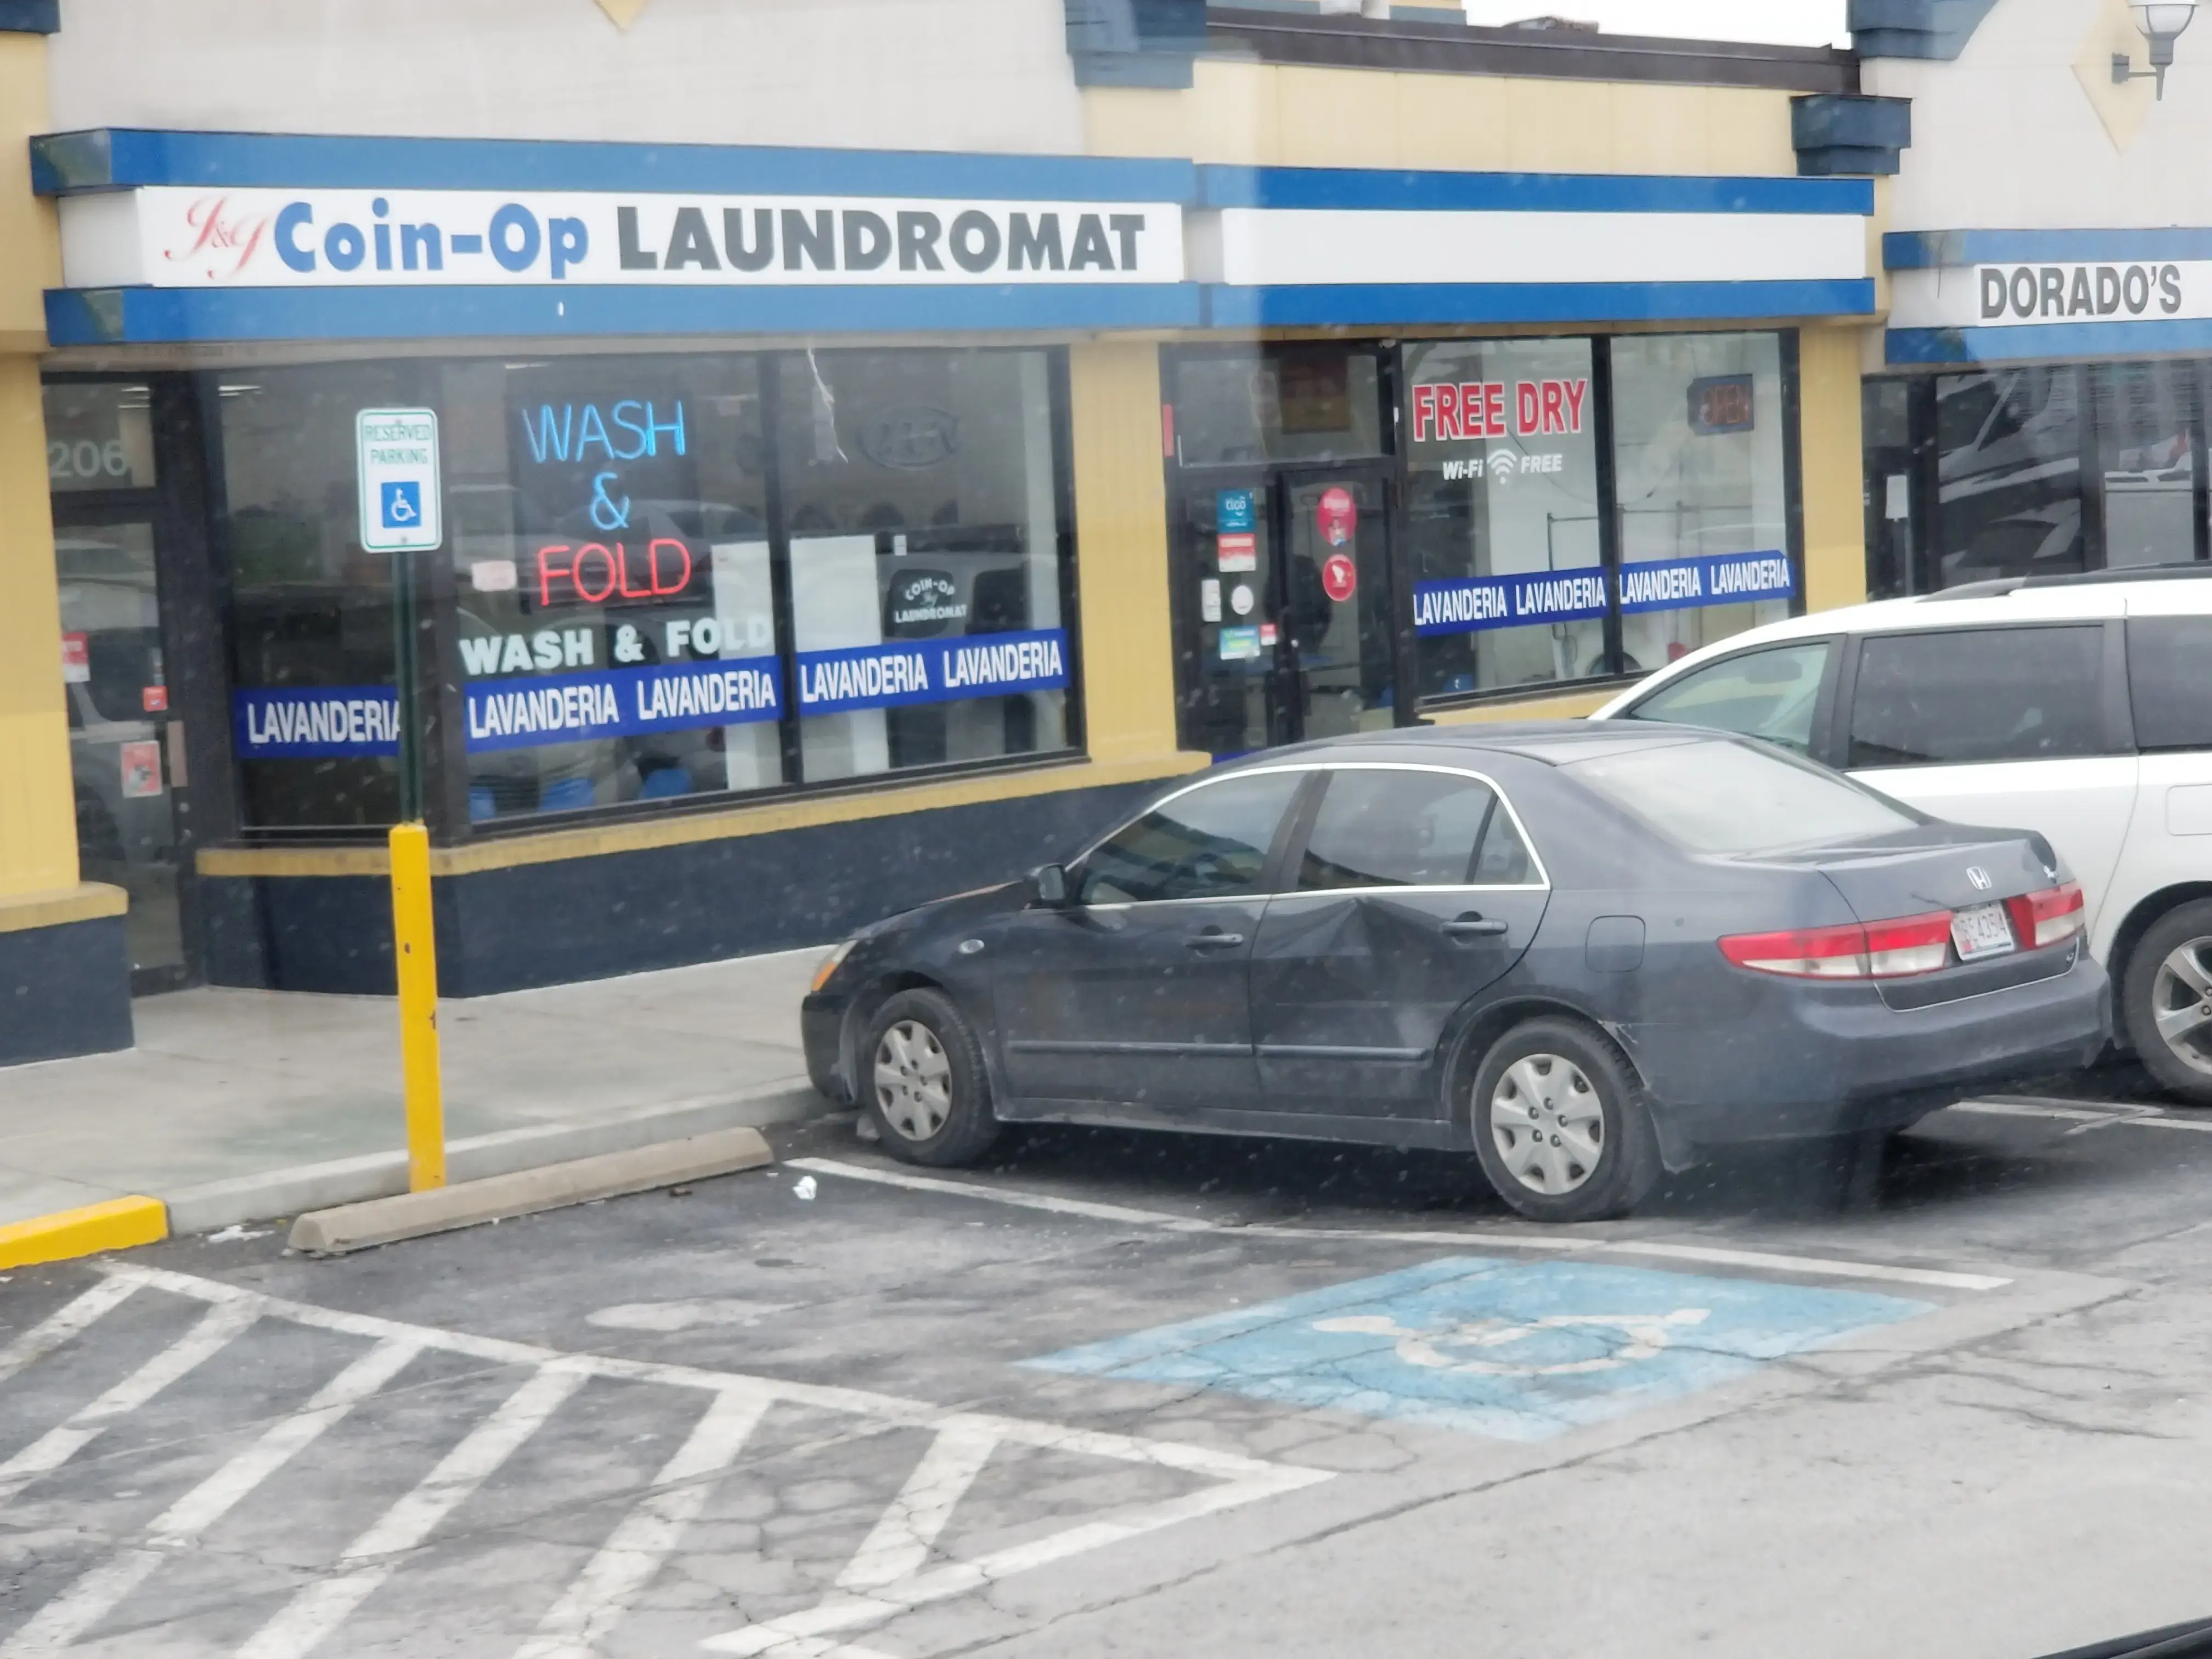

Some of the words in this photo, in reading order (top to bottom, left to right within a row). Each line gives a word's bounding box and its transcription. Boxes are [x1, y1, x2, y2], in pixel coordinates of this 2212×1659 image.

[274, 197, 589, 279] Coin-Op
[617, 206, 1146, 273] LAUNDROMAT
[1980, 264, 2182, 320] DORADO'S
[364, 425, 432, 441] RESERVED
[523, 400, 686, 463] WASH
[1412, 382, 1507, 442] FREE
[1516, 379, 1588, 437] DRY
[48, 439, 128, 477] 206
[370, 448, 428, 465] PARKING
[1442, 459, 1484, 481] Wi-Fi
[1520, 454, 1563, 474] FREE
[590, 472, 630, 530] &
[538, 538, 691, 606] FOLD
[904, 577, 956, 601] COIN-OP
[1619, 567, 1701, 604] LAVANDERIA
[1710, 558, 1791, 595] LAVANDERIA
[895, 603, 967, 623] LAUNDROMAT
[1413, 584, 1507, 627] LAVANDERIA
[1516, 578, 1606, 616] LAVANDERIA
[459, 629, 593, 675] WASH
[614, 624, 645, 662] &
[665, 616, 775, 657] FOLD
[801, 653, 928, 703] LAVANDERIA
[943, 640, 1063, 688] LAVANDERIA
[469, 684, 619, 739] LAVANDERIA
[637, 669, 776, 720] LAVANDERIA
